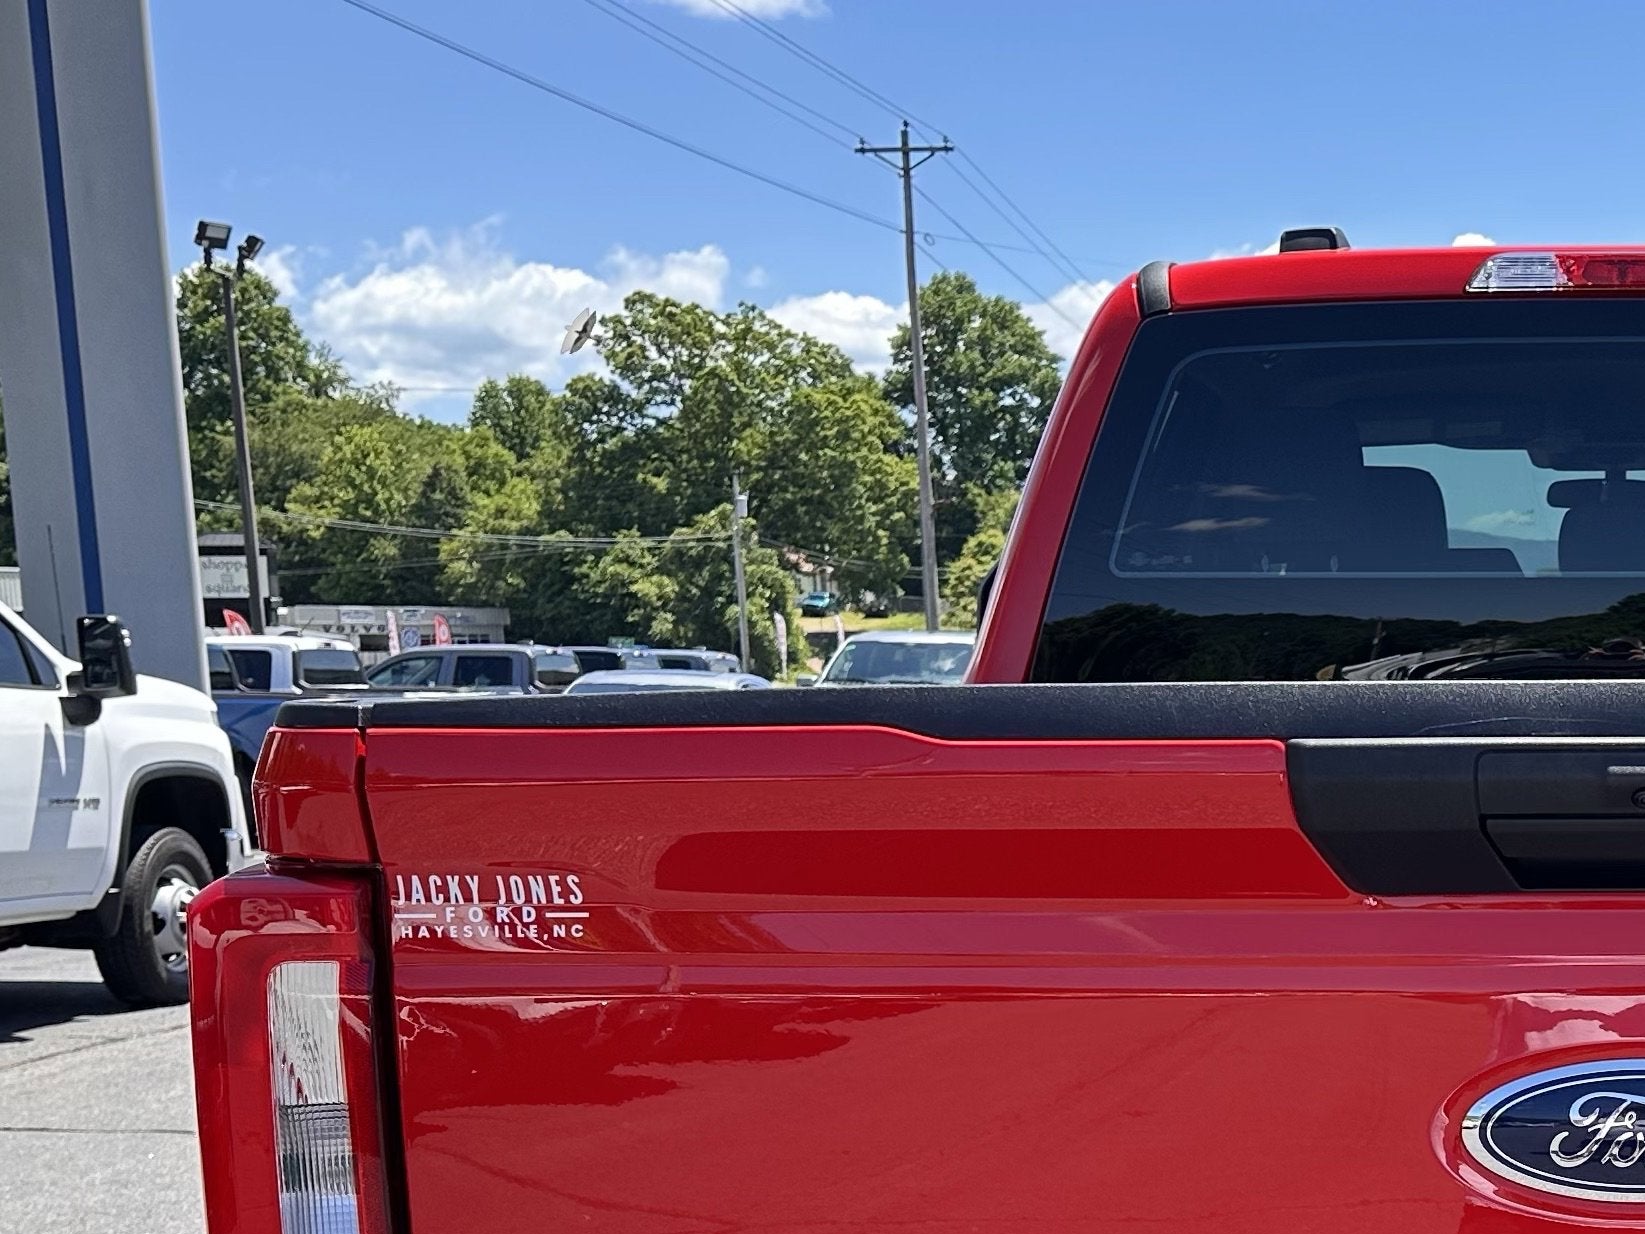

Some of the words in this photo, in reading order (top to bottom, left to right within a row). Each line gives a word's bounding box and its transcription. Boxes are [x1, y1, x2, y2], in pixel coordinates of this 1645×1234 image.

[202, 557, 249, 573] shopp
[322, 624, 386, 633] VOLVO
[395, 874, 480, 905] JACKY
[495, 874, 584, 905] JONES
[445, 906, 537, 923] FORD
